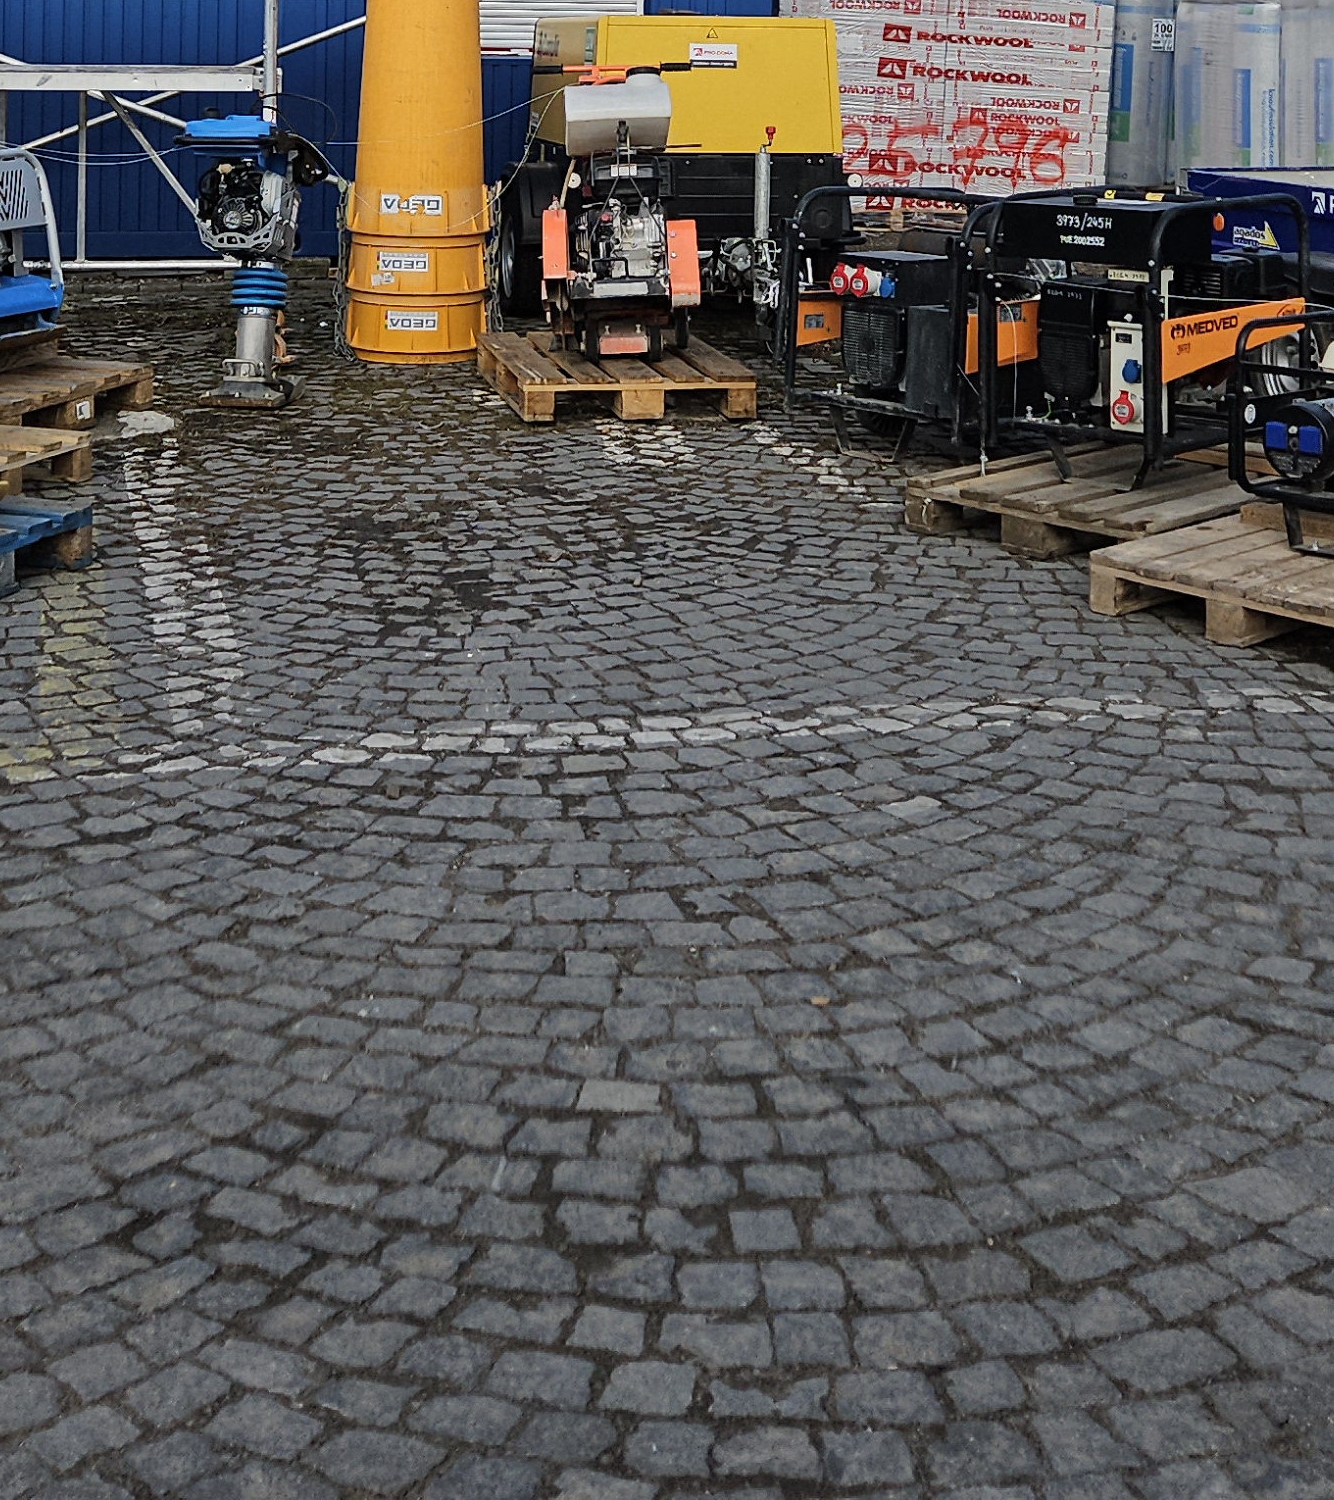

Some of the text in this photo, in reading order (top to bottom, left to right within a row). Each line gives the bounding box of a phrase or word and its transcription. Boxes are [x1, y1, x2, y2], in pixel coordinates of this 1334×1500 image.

[997, 8, 1066, 24] ROCKWOOL
[1154, 23, 1173, 34] 100
[917, 31, 1034, 49] ROCKWOOL
[911, 64, 1033, 86] ROCKWOOL
[990, 96, 1060, 112] ROCKWOOL
[382, 259, 427, 269] GEDA
[389, 318, 436, 328] GEDA
[1187, 315, 1238, 337] MEDVED
